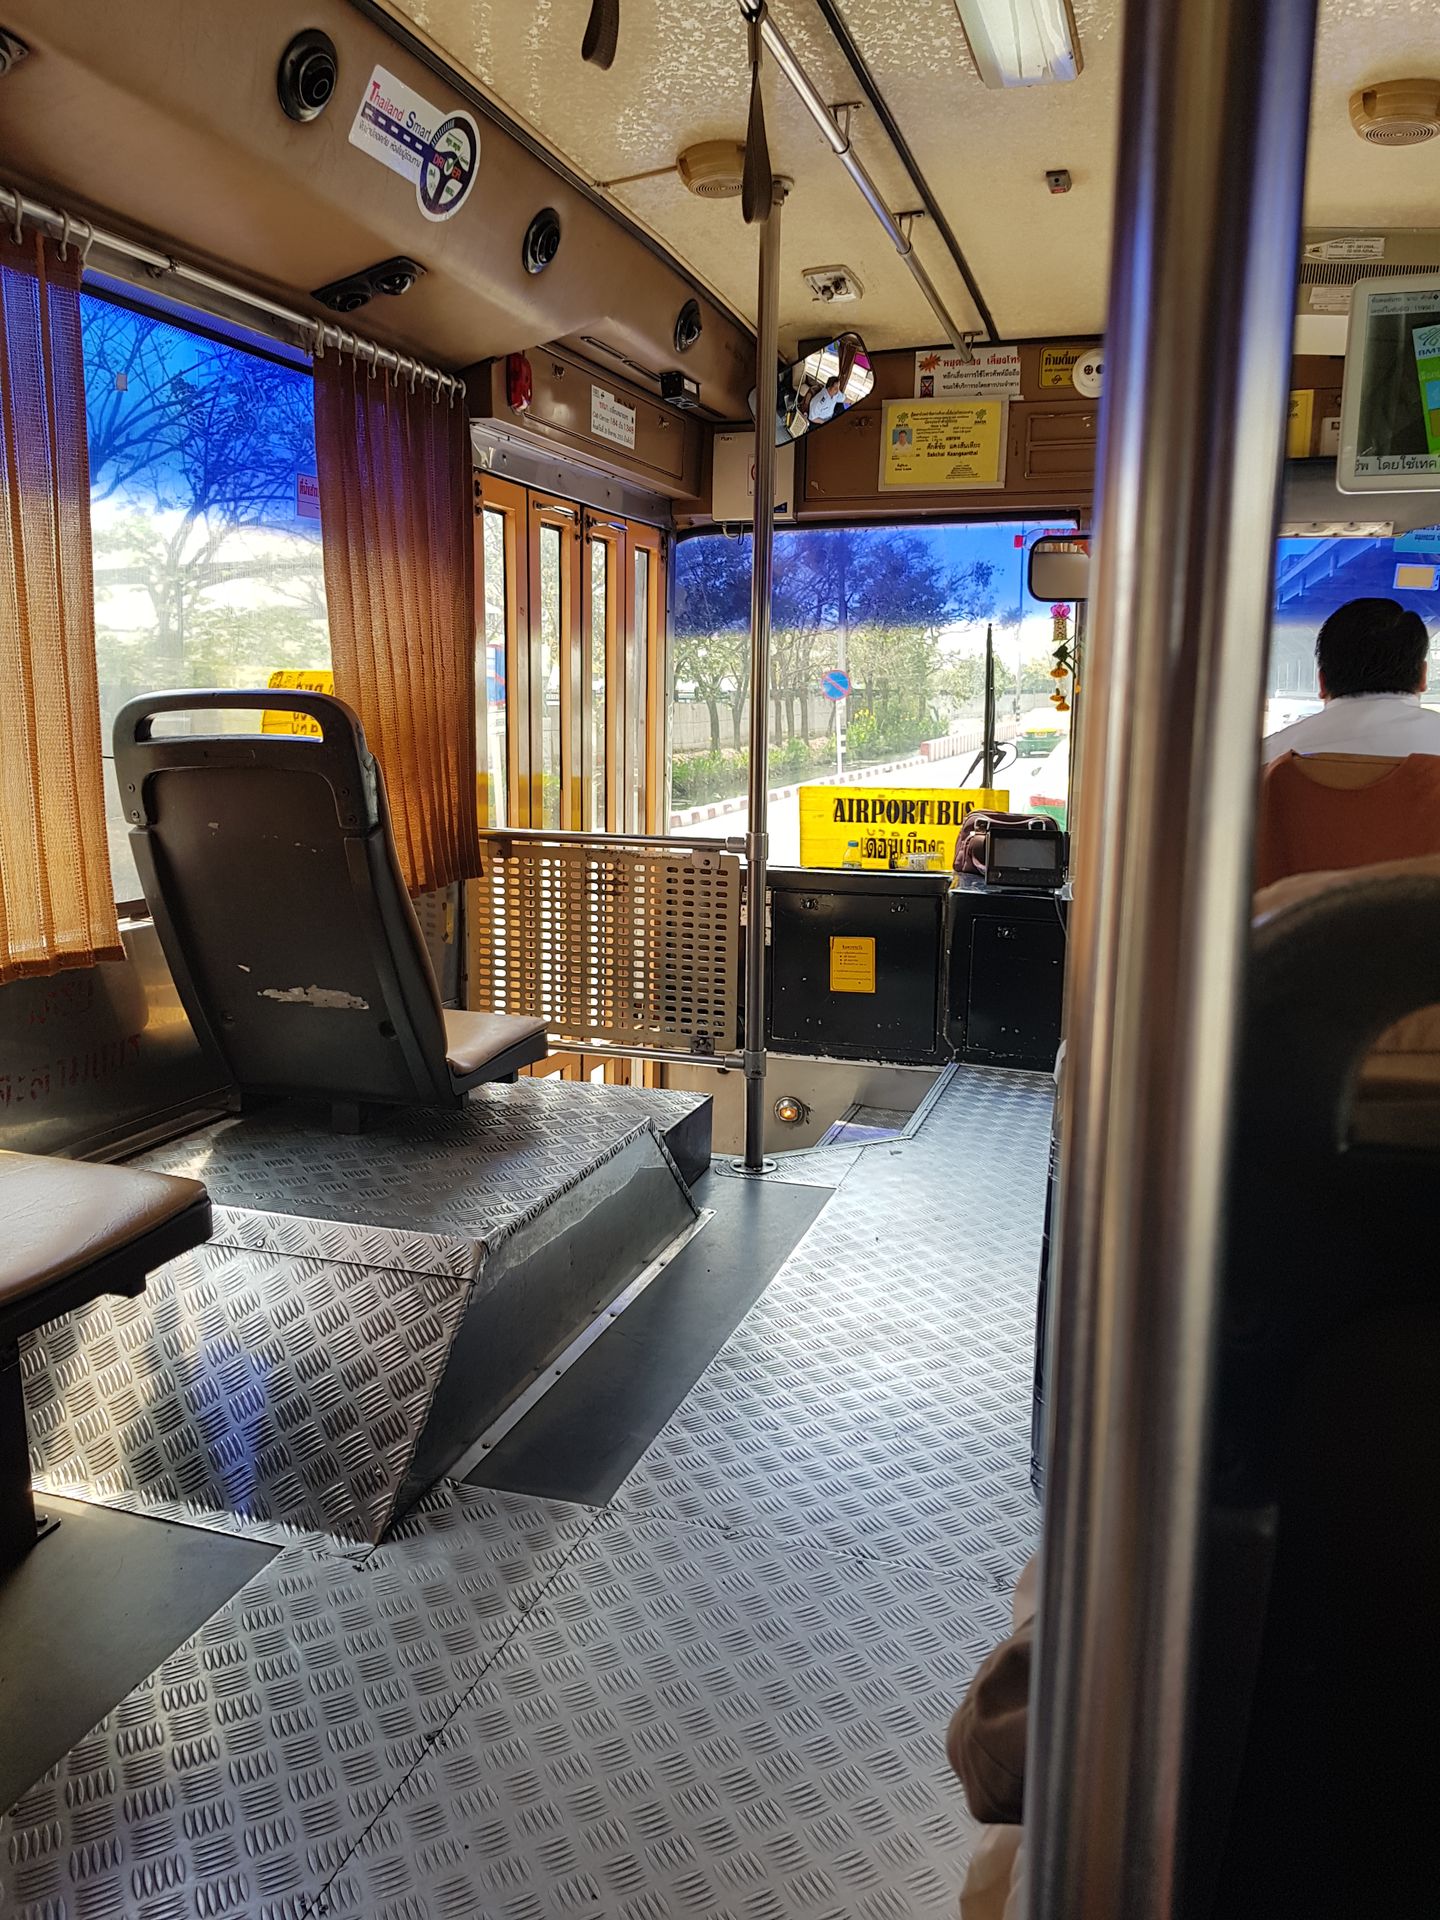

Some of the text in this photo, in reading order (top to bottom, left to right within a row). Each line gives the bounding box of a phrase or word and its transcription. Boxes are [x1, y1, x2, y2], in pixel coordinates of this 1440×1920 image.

[370, 81, 432, 142] Thailand Smart
[833, 798, 929, 825] AIRPORT
